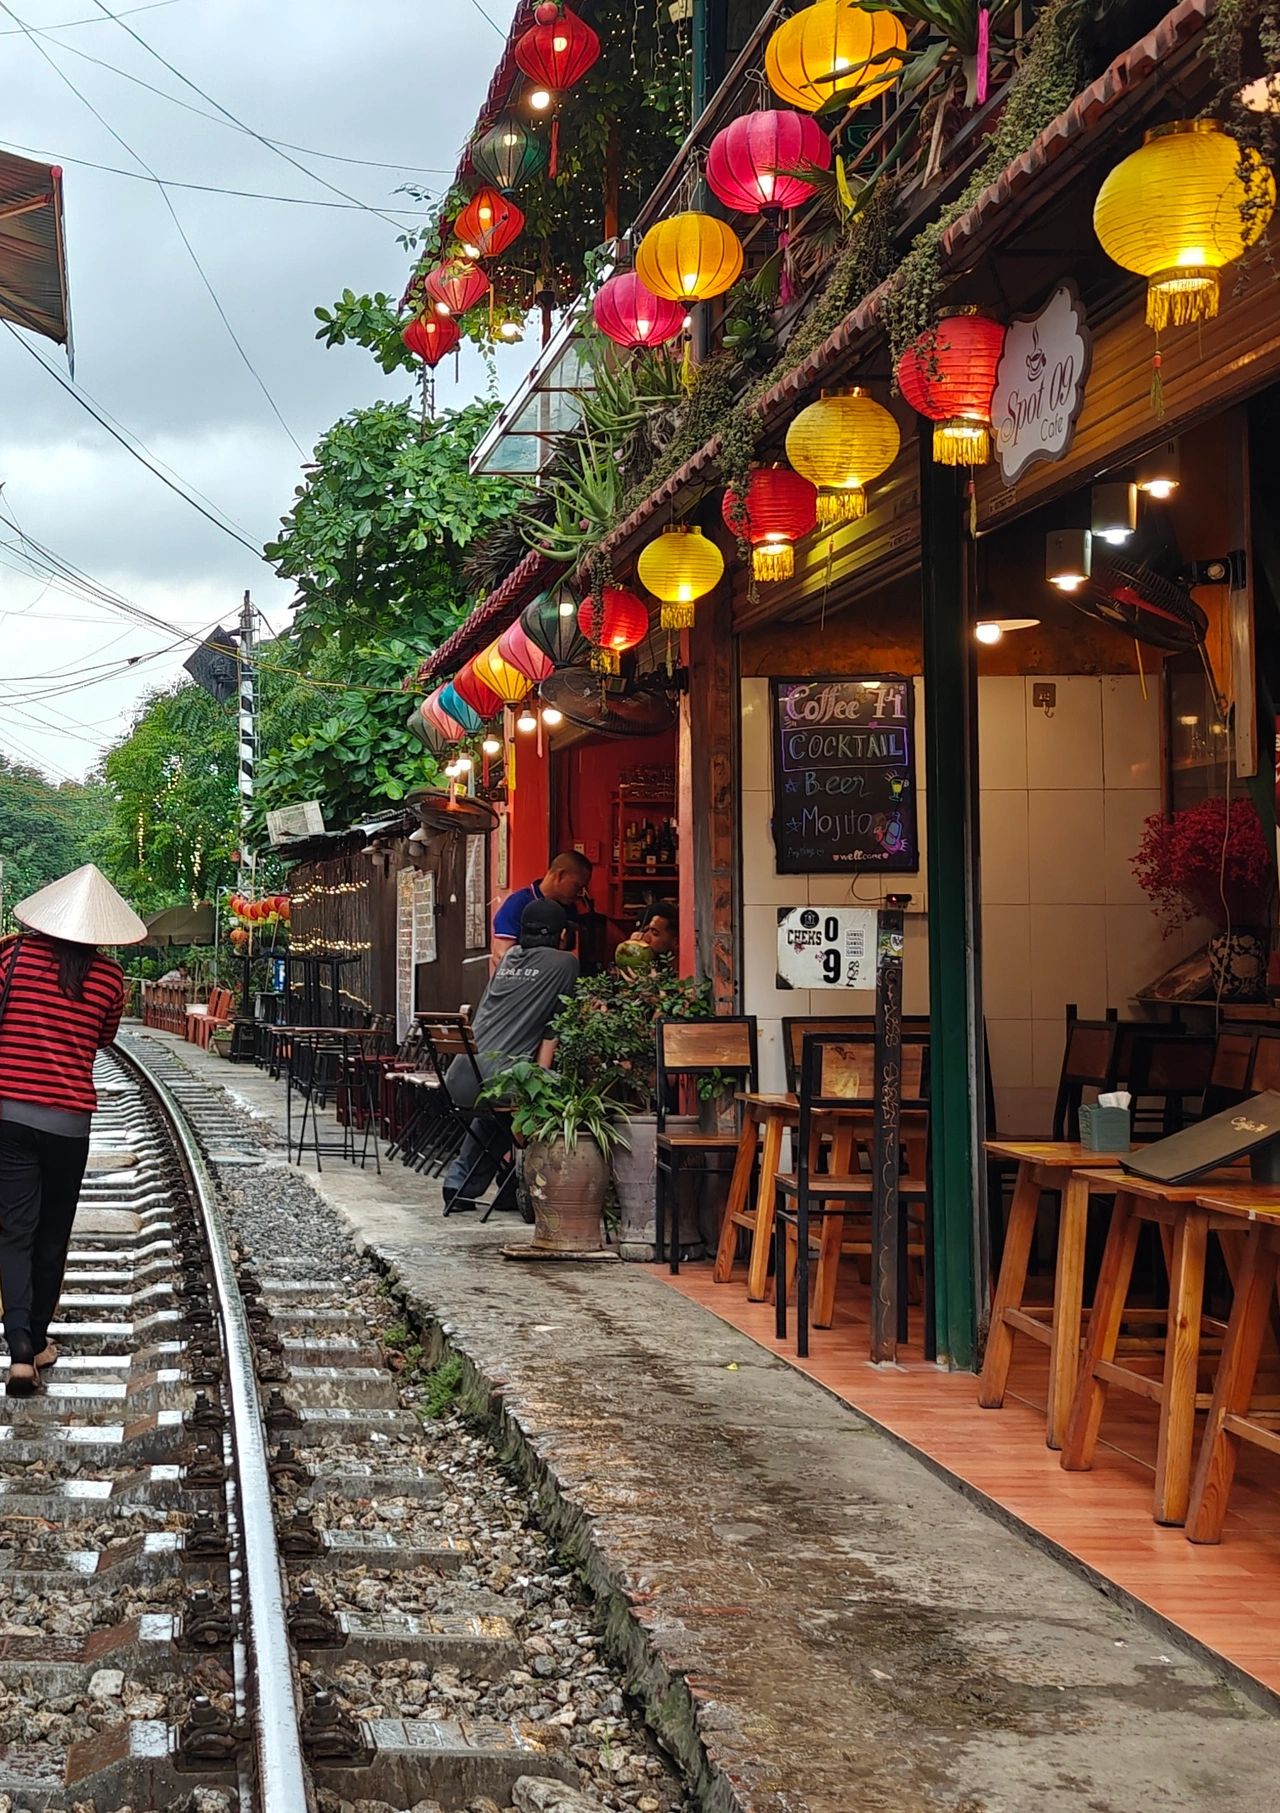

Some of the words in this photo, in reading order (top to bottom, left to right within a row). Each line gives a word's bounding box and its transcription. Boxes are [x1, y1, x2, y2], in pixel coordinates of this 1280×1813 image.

[1000, 378, 1046, 447] Spot
[1049, 355, 1074, 411] 09
[1040, 415, 1064, 442] Cafe
[786, 685, 861, 724] Coffee
[789, 731, 903, 760] COCKTAIL
[805, 771, 872, 798] Beer
[802, 805, 872, 841] Mojito
